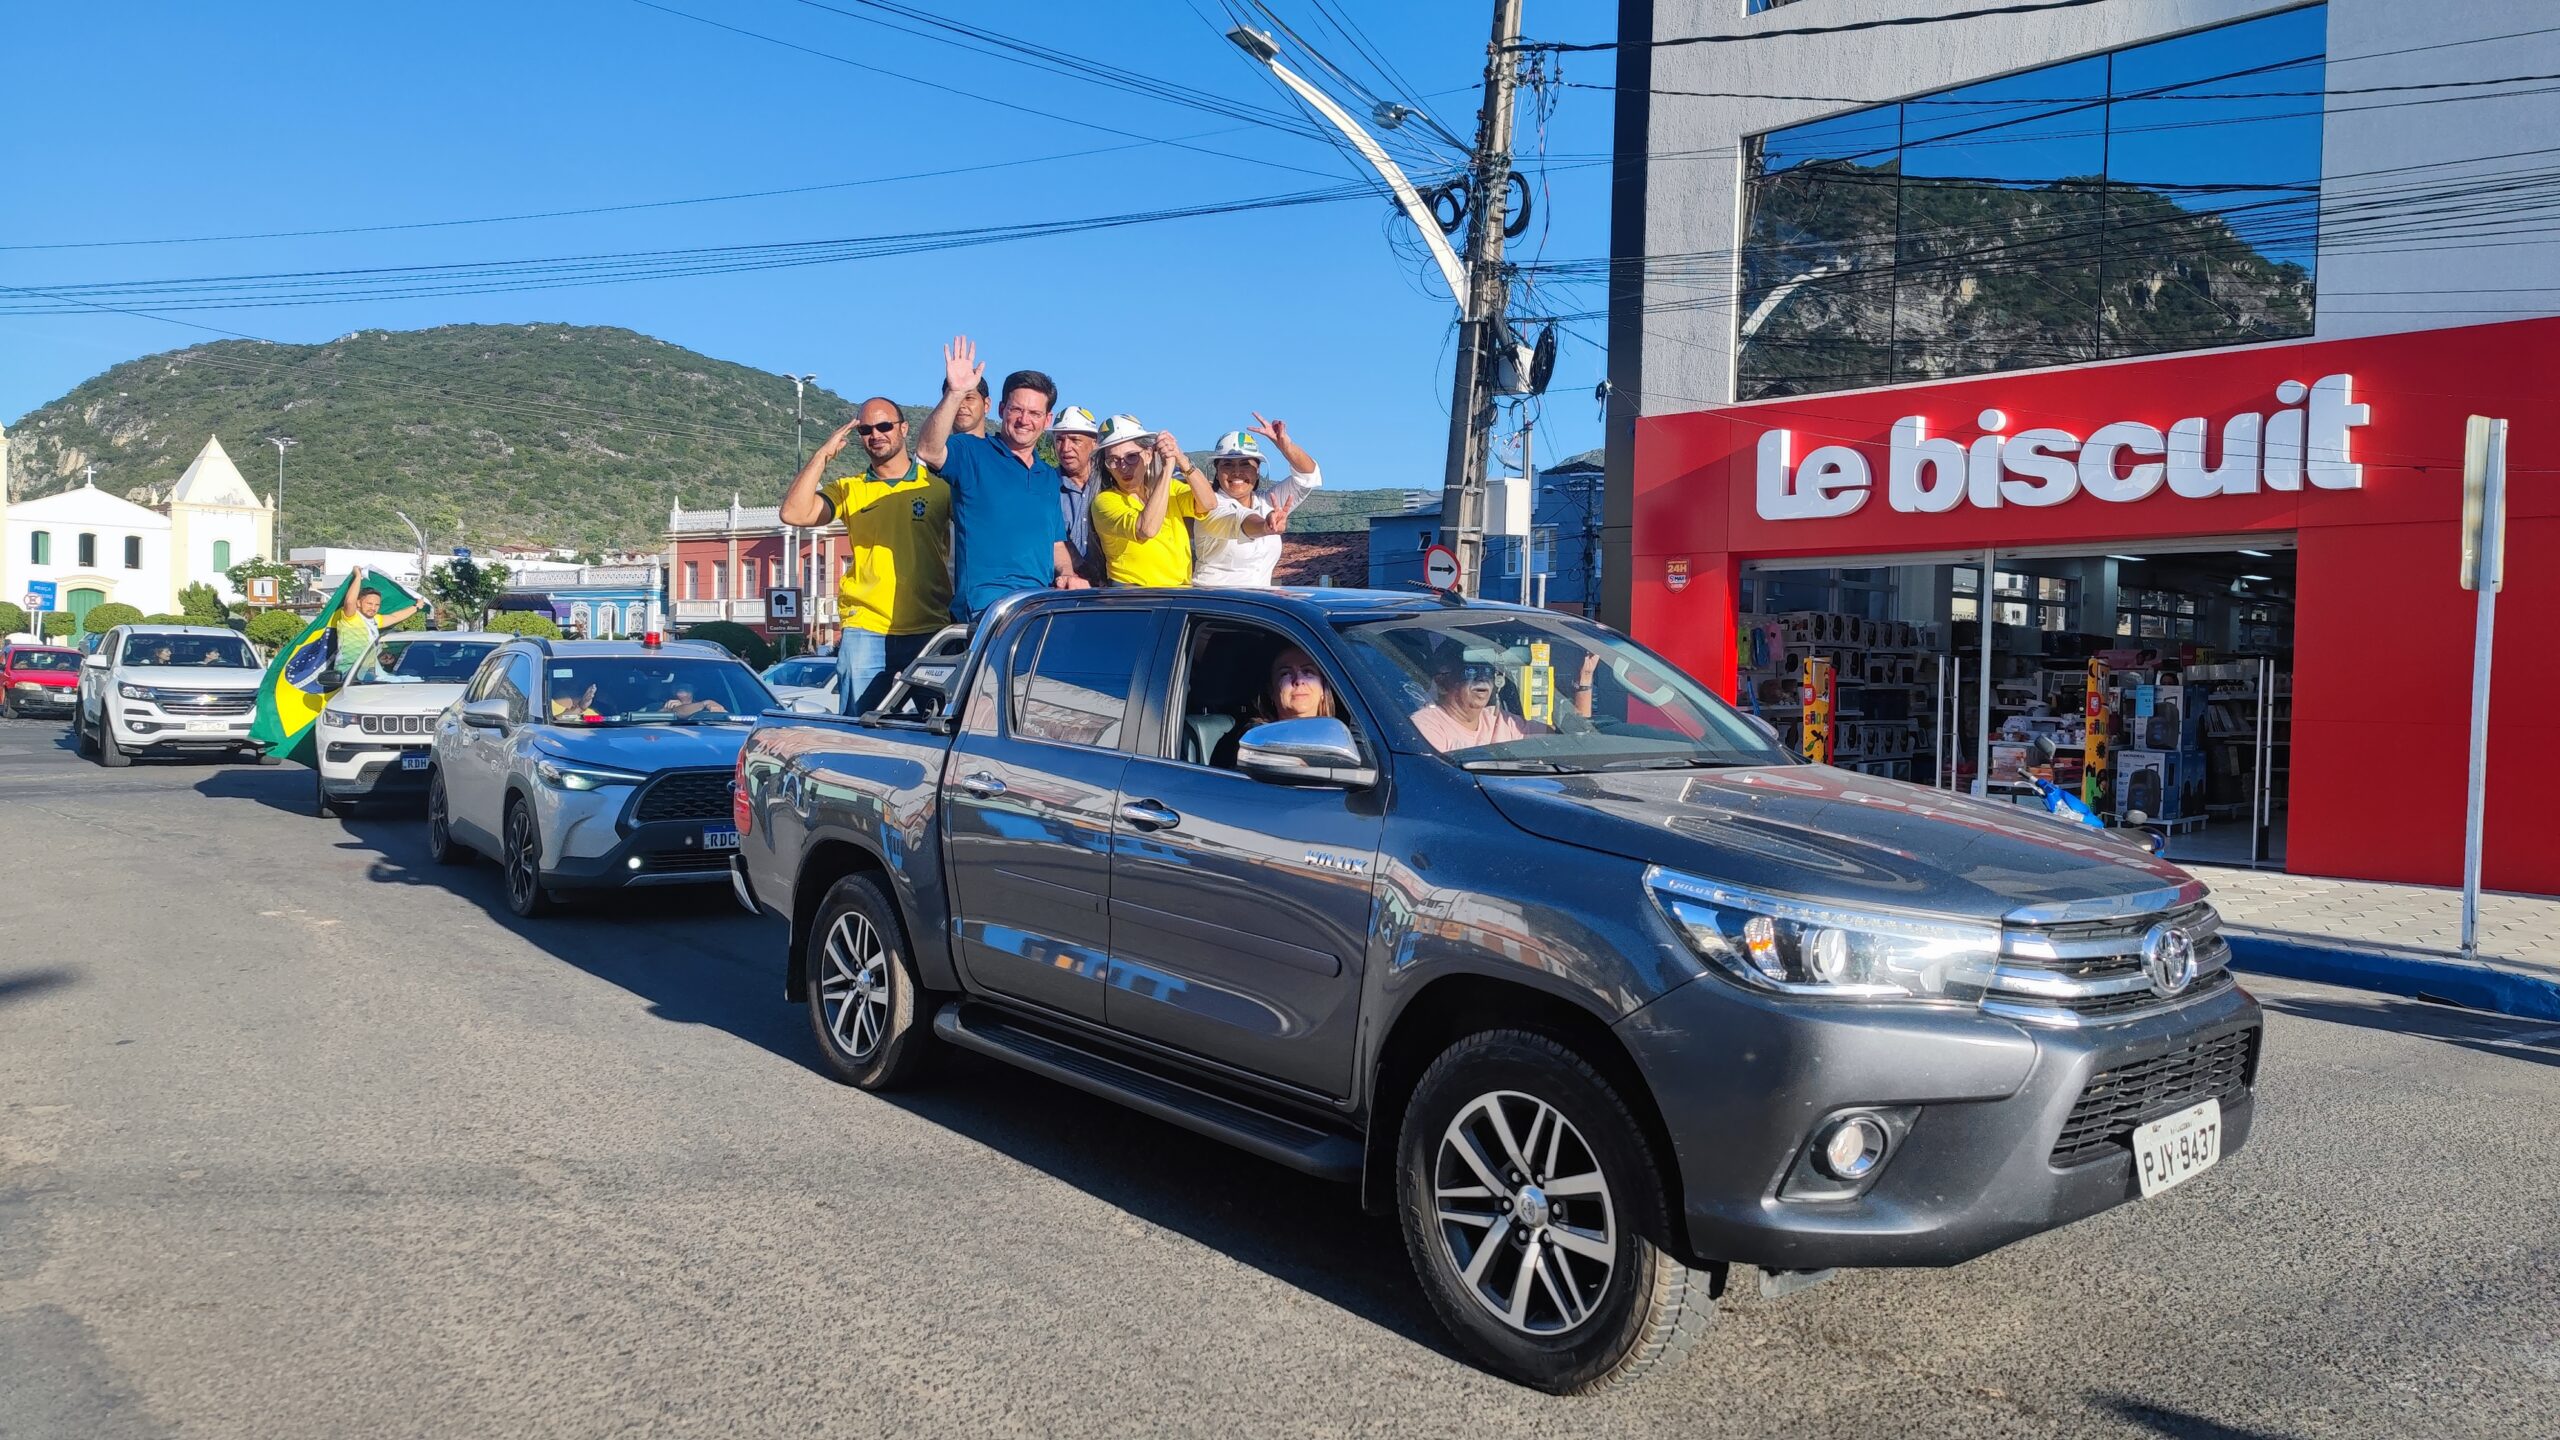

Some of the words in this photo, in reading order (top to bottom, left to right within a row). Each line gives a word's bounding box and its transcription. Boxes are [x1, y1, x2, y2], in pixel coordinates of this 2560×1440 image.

[1757, 428, 1871, 520] Le
[1889, 373, 2370, 513] biscuit
[1668, 564, 1687, 573] 24H
[407, 760, 427, 768] RDH
[1304, 850, 1368, 877] HILUX
[1678, 883, 1711, 896] HILUX
[2143, 1124, 2216, 1187] PJY-9437
